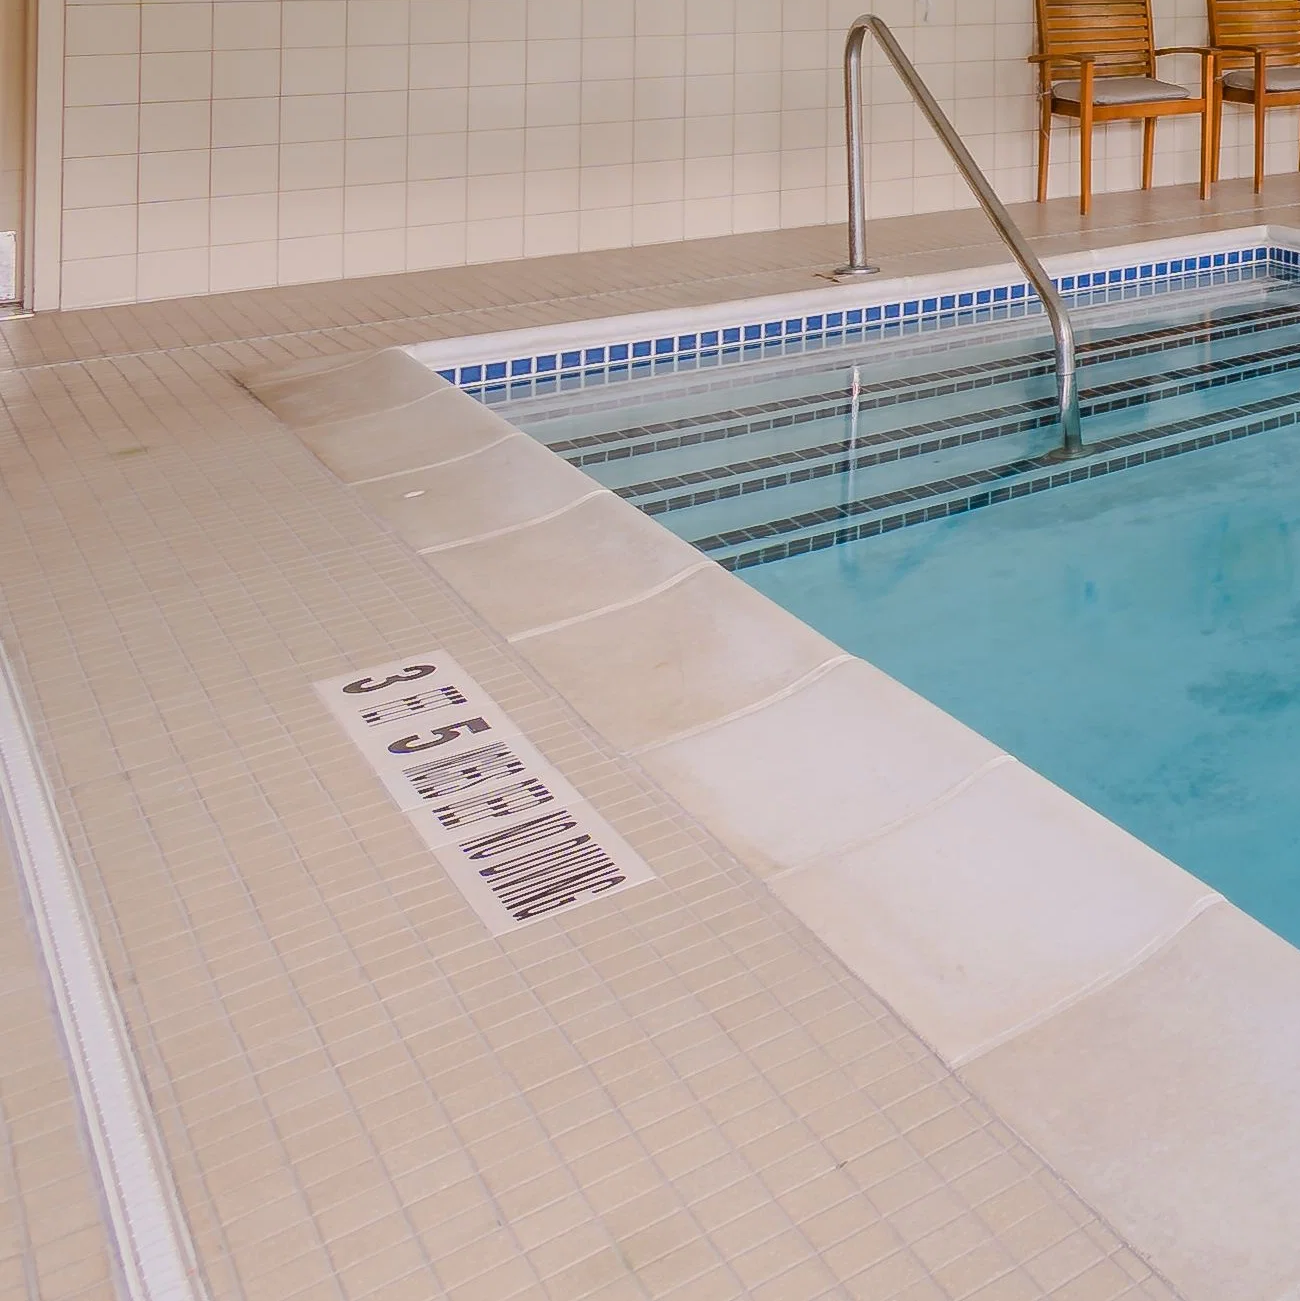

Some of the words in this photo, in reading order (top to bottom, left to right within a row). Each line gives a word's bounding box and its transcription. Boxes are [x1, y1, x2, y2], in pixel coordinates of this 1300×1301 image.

[342, 664, 437, 694] 3
[358, 685, 468, 727] FEET
[388, 716, 493, 754] 5
[402, 741, 527, 800] INCHES
[432, 778, 555, 830] DEEP
[459, 810, 578, 860] NO
[479, 833, 627, 922] DIVING
